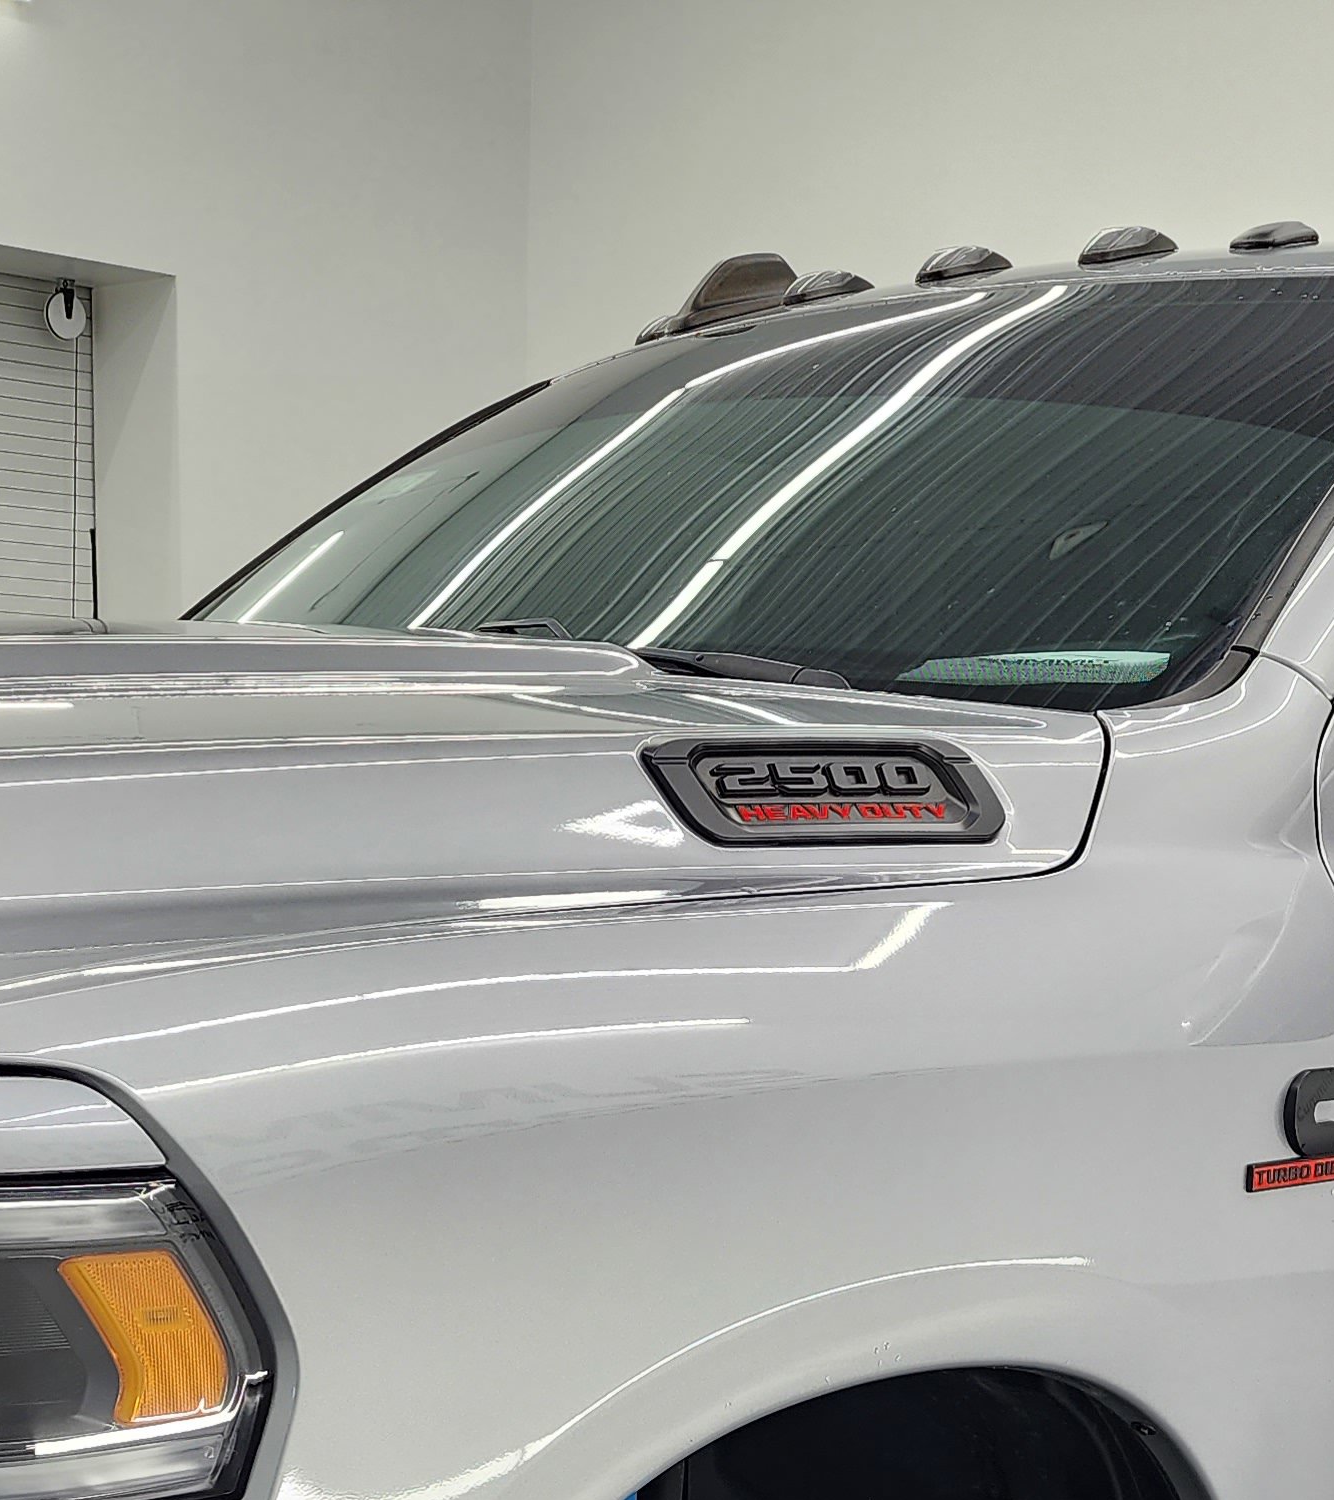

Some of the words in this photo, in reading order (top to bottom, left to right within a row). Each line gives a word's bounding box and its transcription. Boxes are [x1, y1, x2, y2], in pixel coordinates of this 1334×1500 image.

[709, 761, 932, 798] 2500
[737, 803, 851, 823] HEAVY
[859, 802, 947, 820] DUTY
[1255, 1163, 1311, 1186] TURBO
